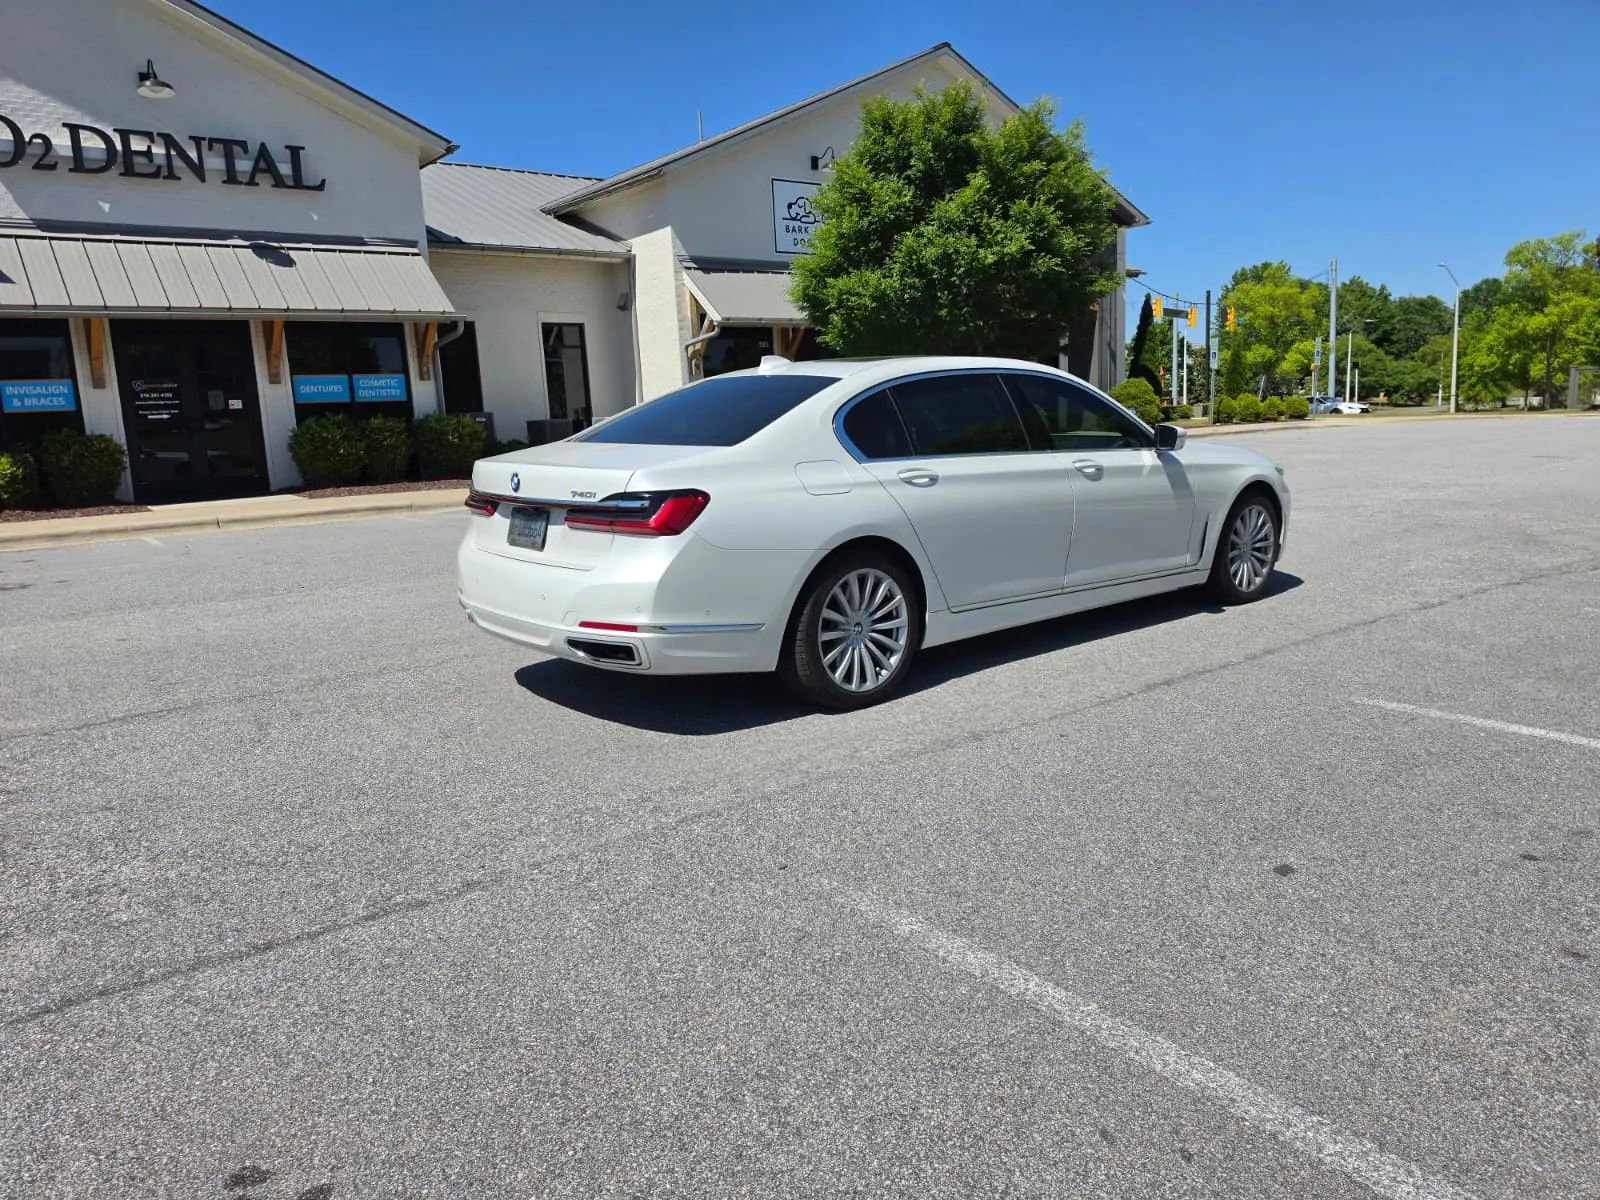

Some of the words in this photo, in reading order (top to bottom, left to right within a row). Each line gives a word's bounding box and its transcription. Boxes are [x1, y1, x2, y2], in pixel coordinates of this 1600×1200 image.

[61, 121, 326, 192] DENTAL
[785, 224, 809, 234] BARK
[359, 378, 399, 387] COSMETIC
[6, 384, 68, 395] INVISALIGN
[299, 384, 344, 394] DENTURES
[359, 388, 401, 397] DENTISTRY
[12, 397, 22, 407] &
[24, 396, 65, 407] BRACES
